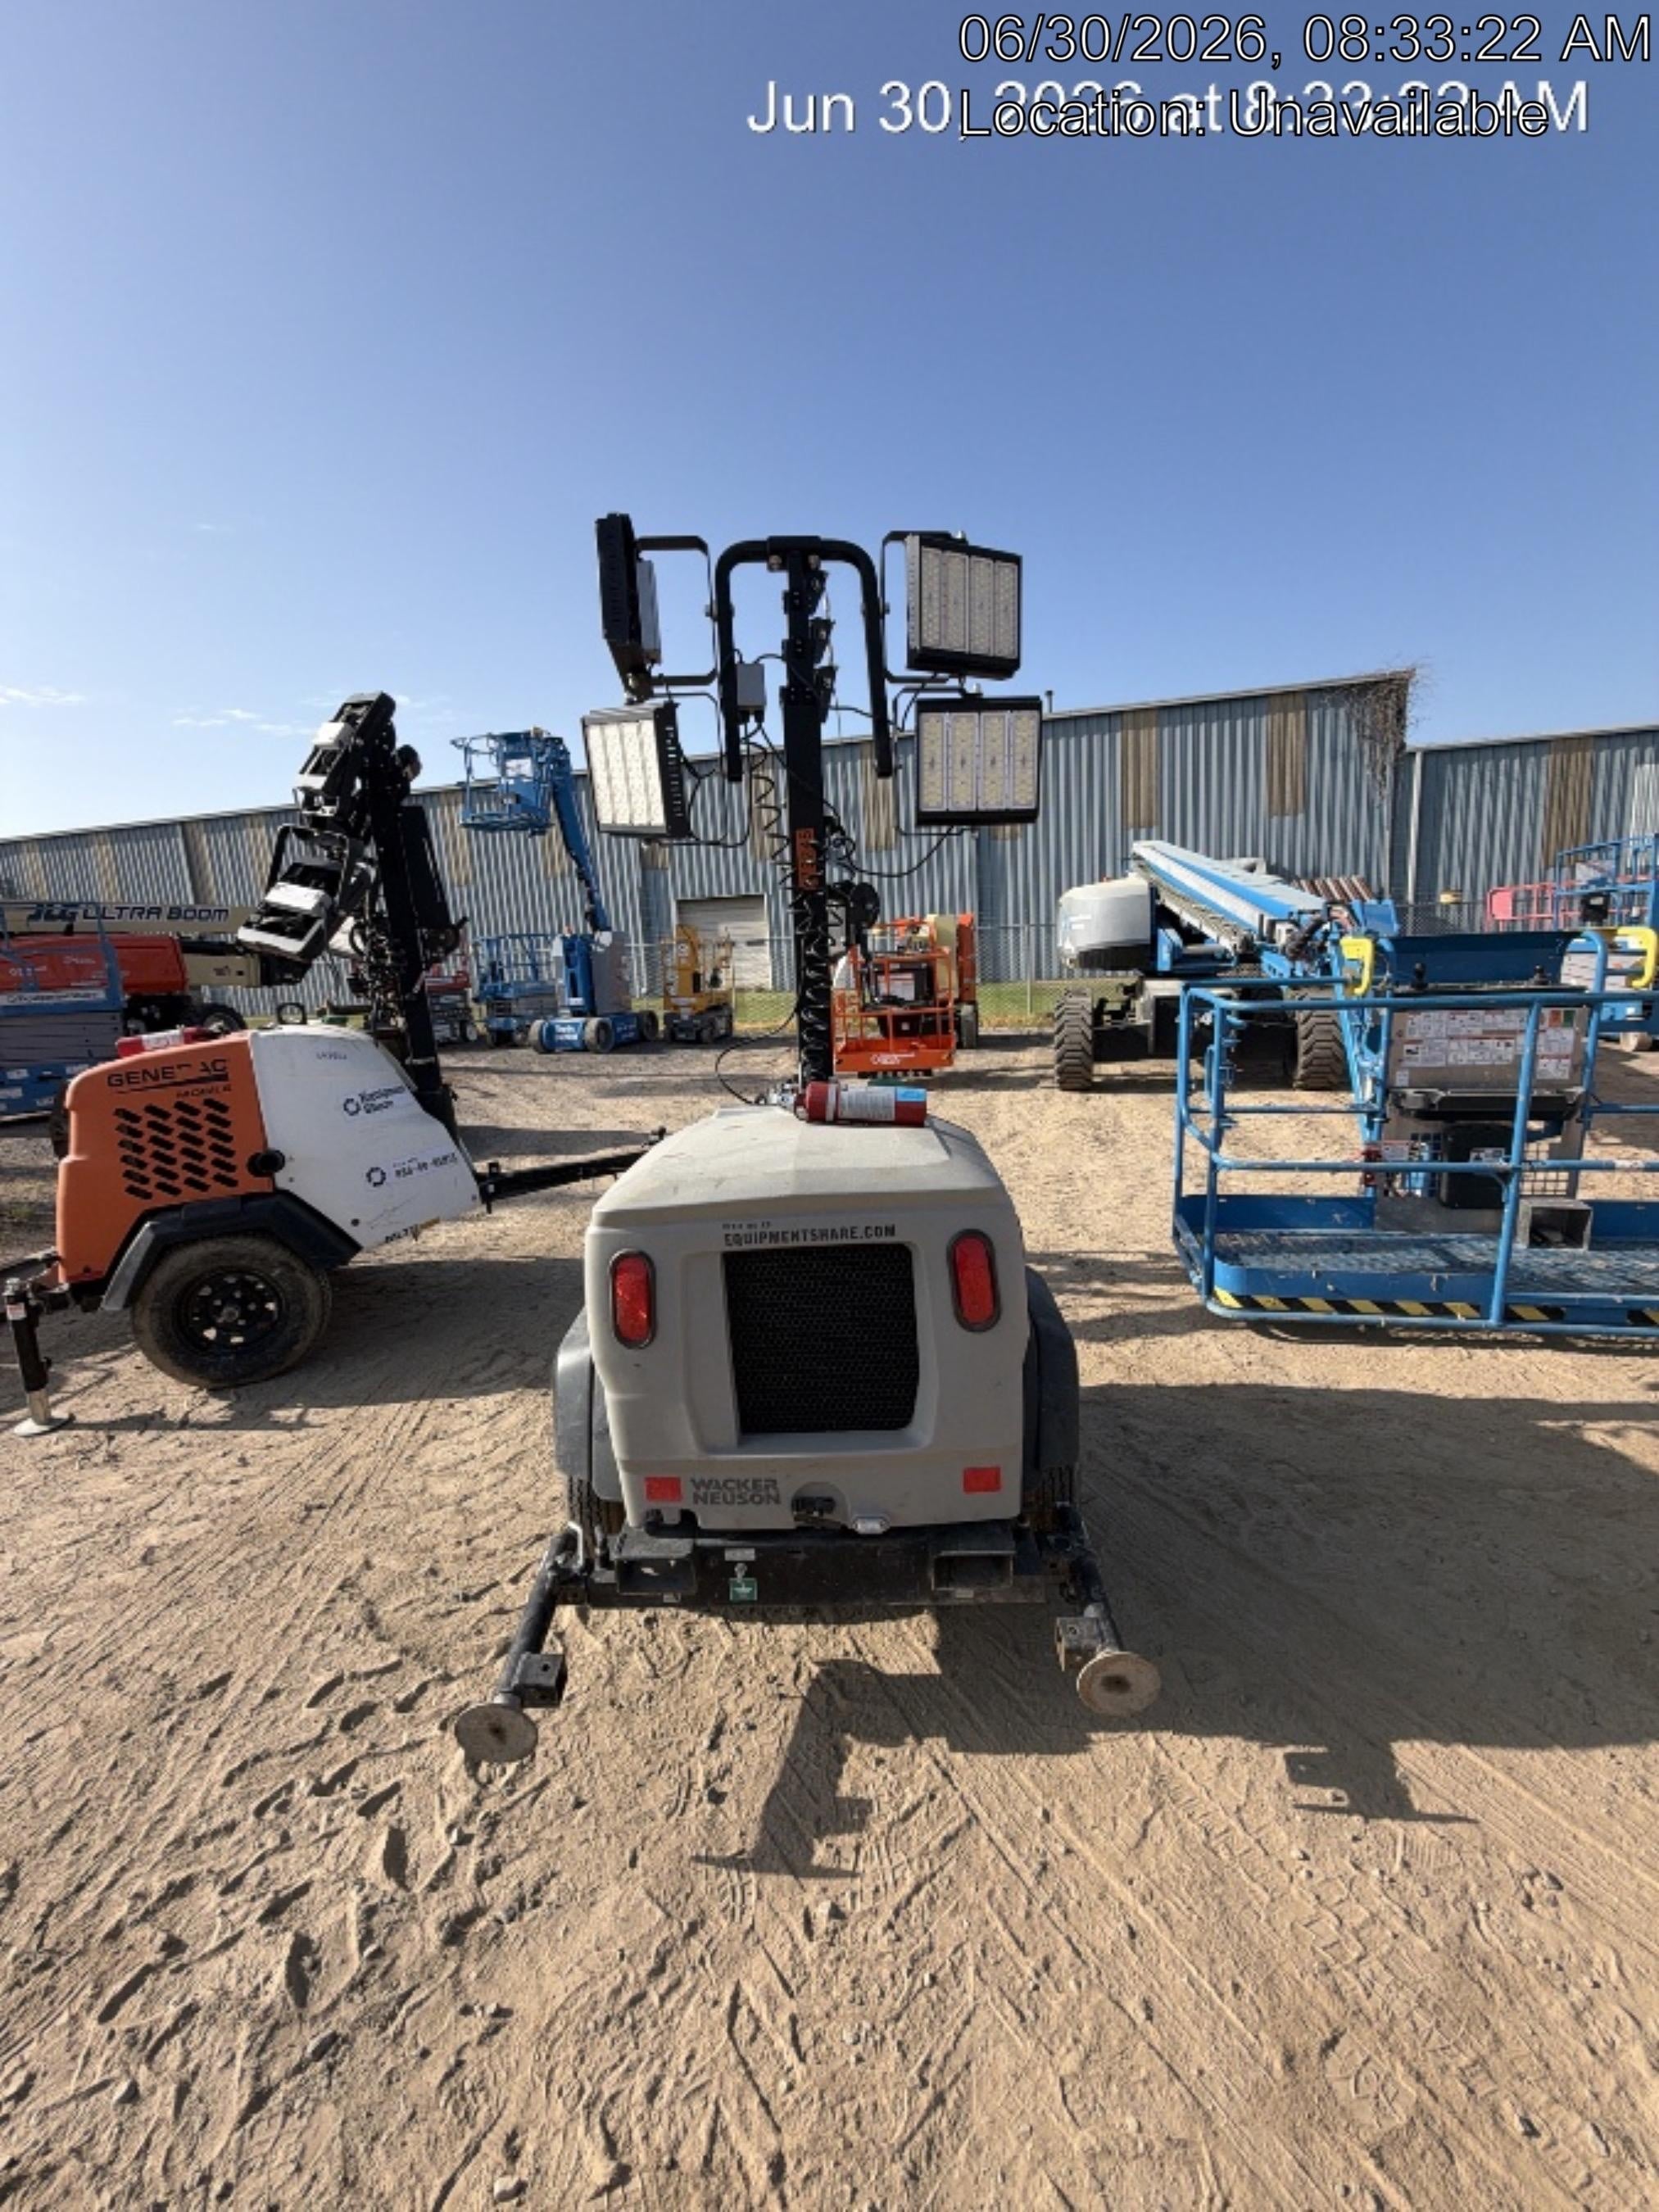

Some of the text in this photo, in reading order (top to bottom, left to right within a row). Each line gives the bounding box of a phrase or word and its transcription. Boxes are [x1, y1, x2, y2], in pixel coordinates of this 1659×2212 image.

[82, 906, 161, 920] ULTRA
[166, 909, 229, 922] BOOM
[107, 1059, 227, 1087] GENEAC
[690, 1478, 779, 1490] WACKER
[692, 1491, 782, 1505] NEUSON
